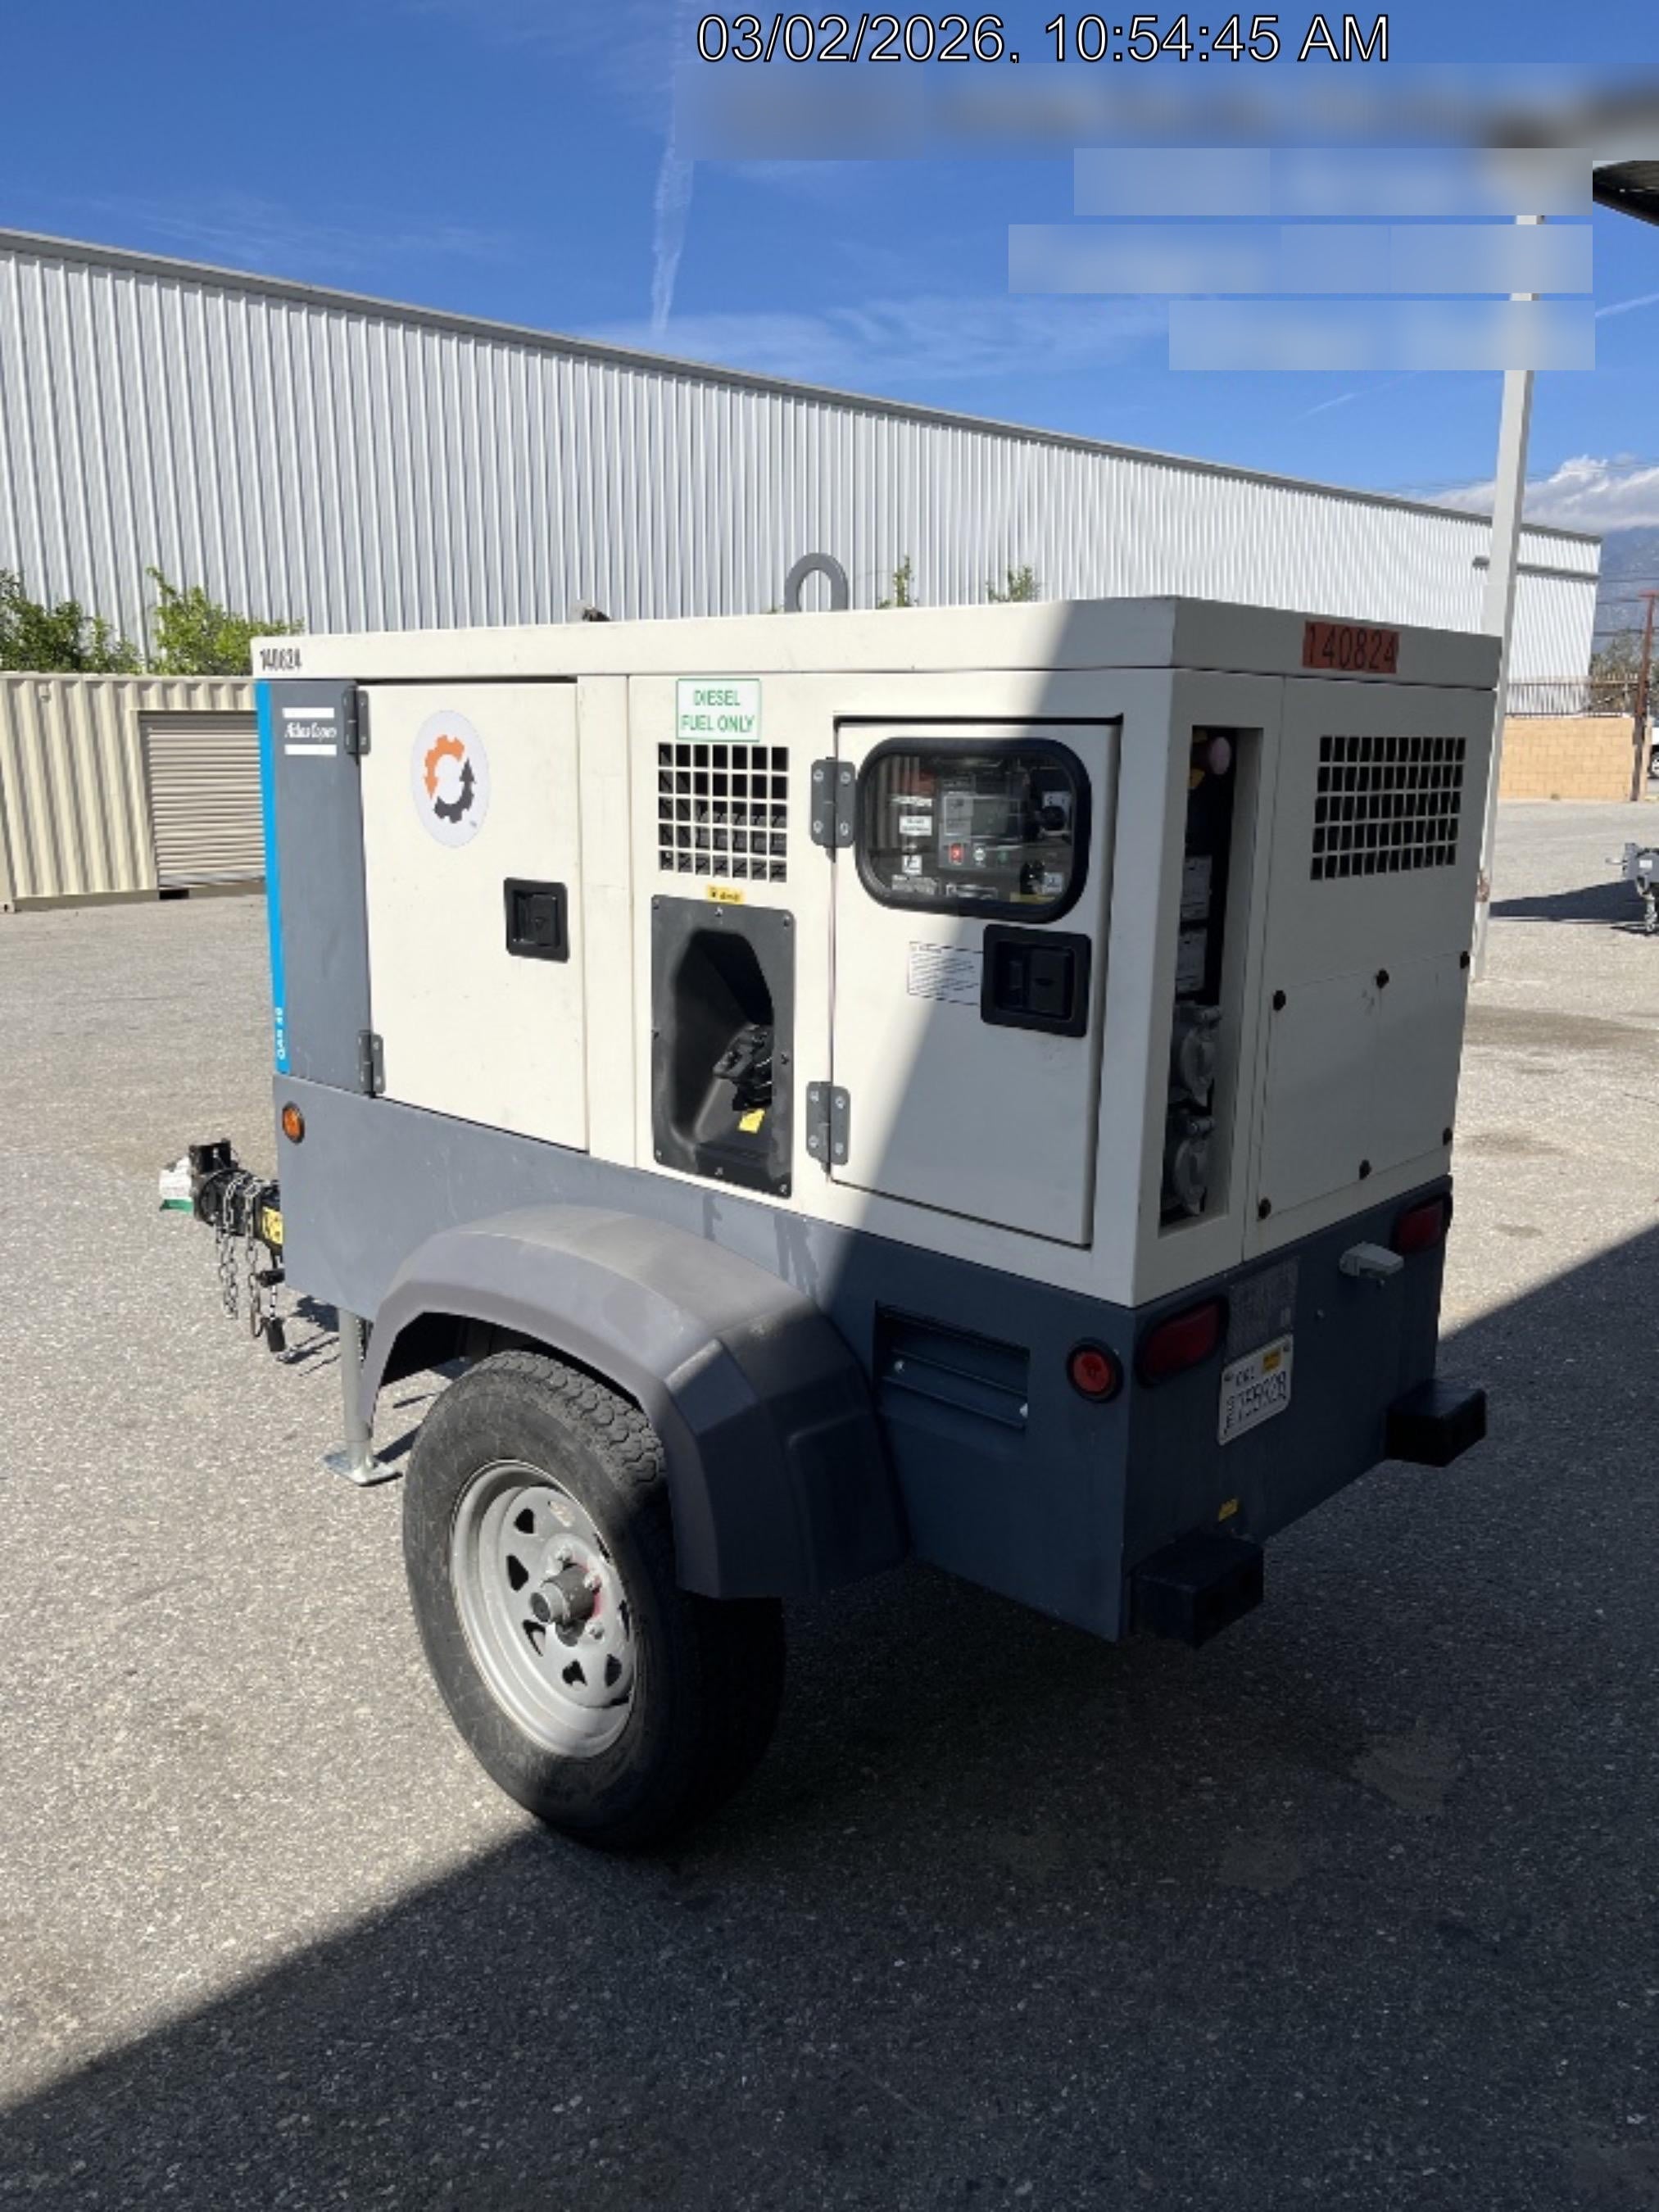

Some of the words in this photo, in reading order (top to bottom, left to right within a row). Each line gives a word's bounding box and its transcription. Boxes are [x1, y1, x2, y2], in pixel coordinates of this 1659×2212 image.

[1308, 623, 1397, 672] 140824
[693, 689, 741, 706] DIESEL
[681, 714, 714, 731] FUEL
[717, 714, 755, 733] ONLY
